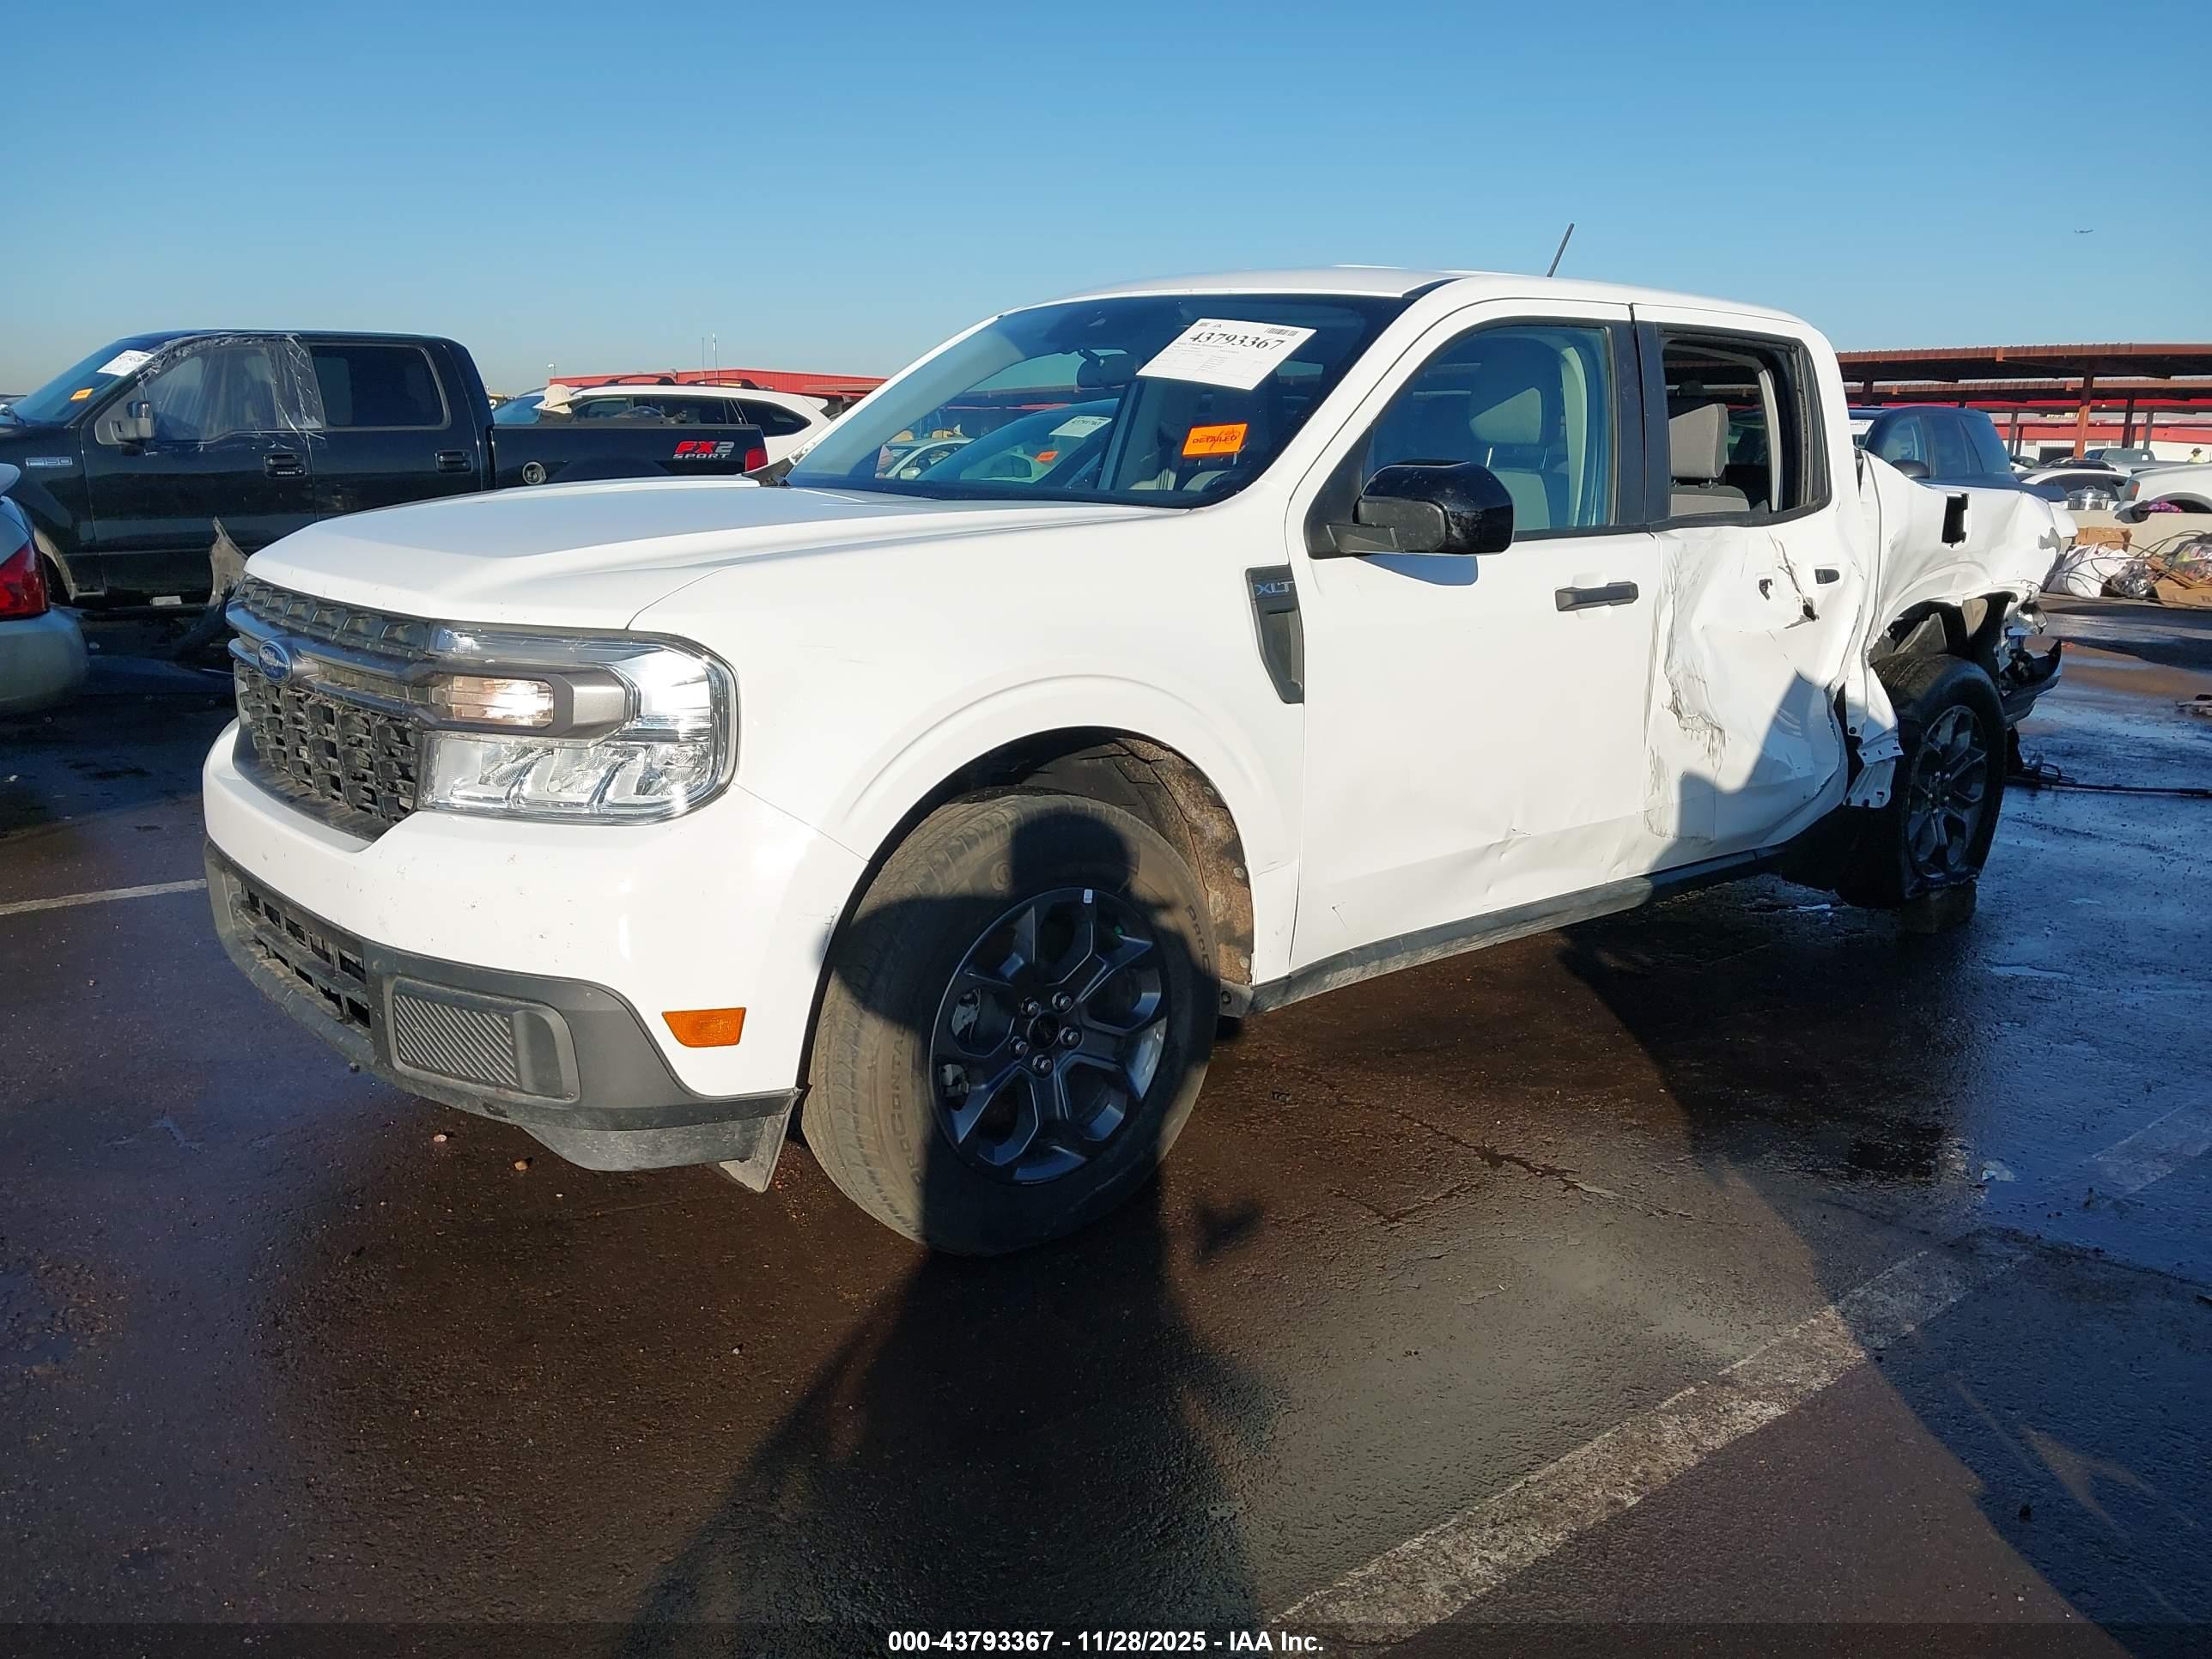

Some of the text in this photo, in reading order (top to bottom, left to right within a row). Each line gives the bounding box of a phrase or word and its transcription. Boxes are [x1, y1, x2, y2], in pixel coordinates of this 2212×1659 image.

[1189, 331, 1285, 350] 43793367
[675, 441, 735, 453] FX2
[1192, 435, 1237, 445] DETAILED
[1254, 580, 1294, 596] XLT
